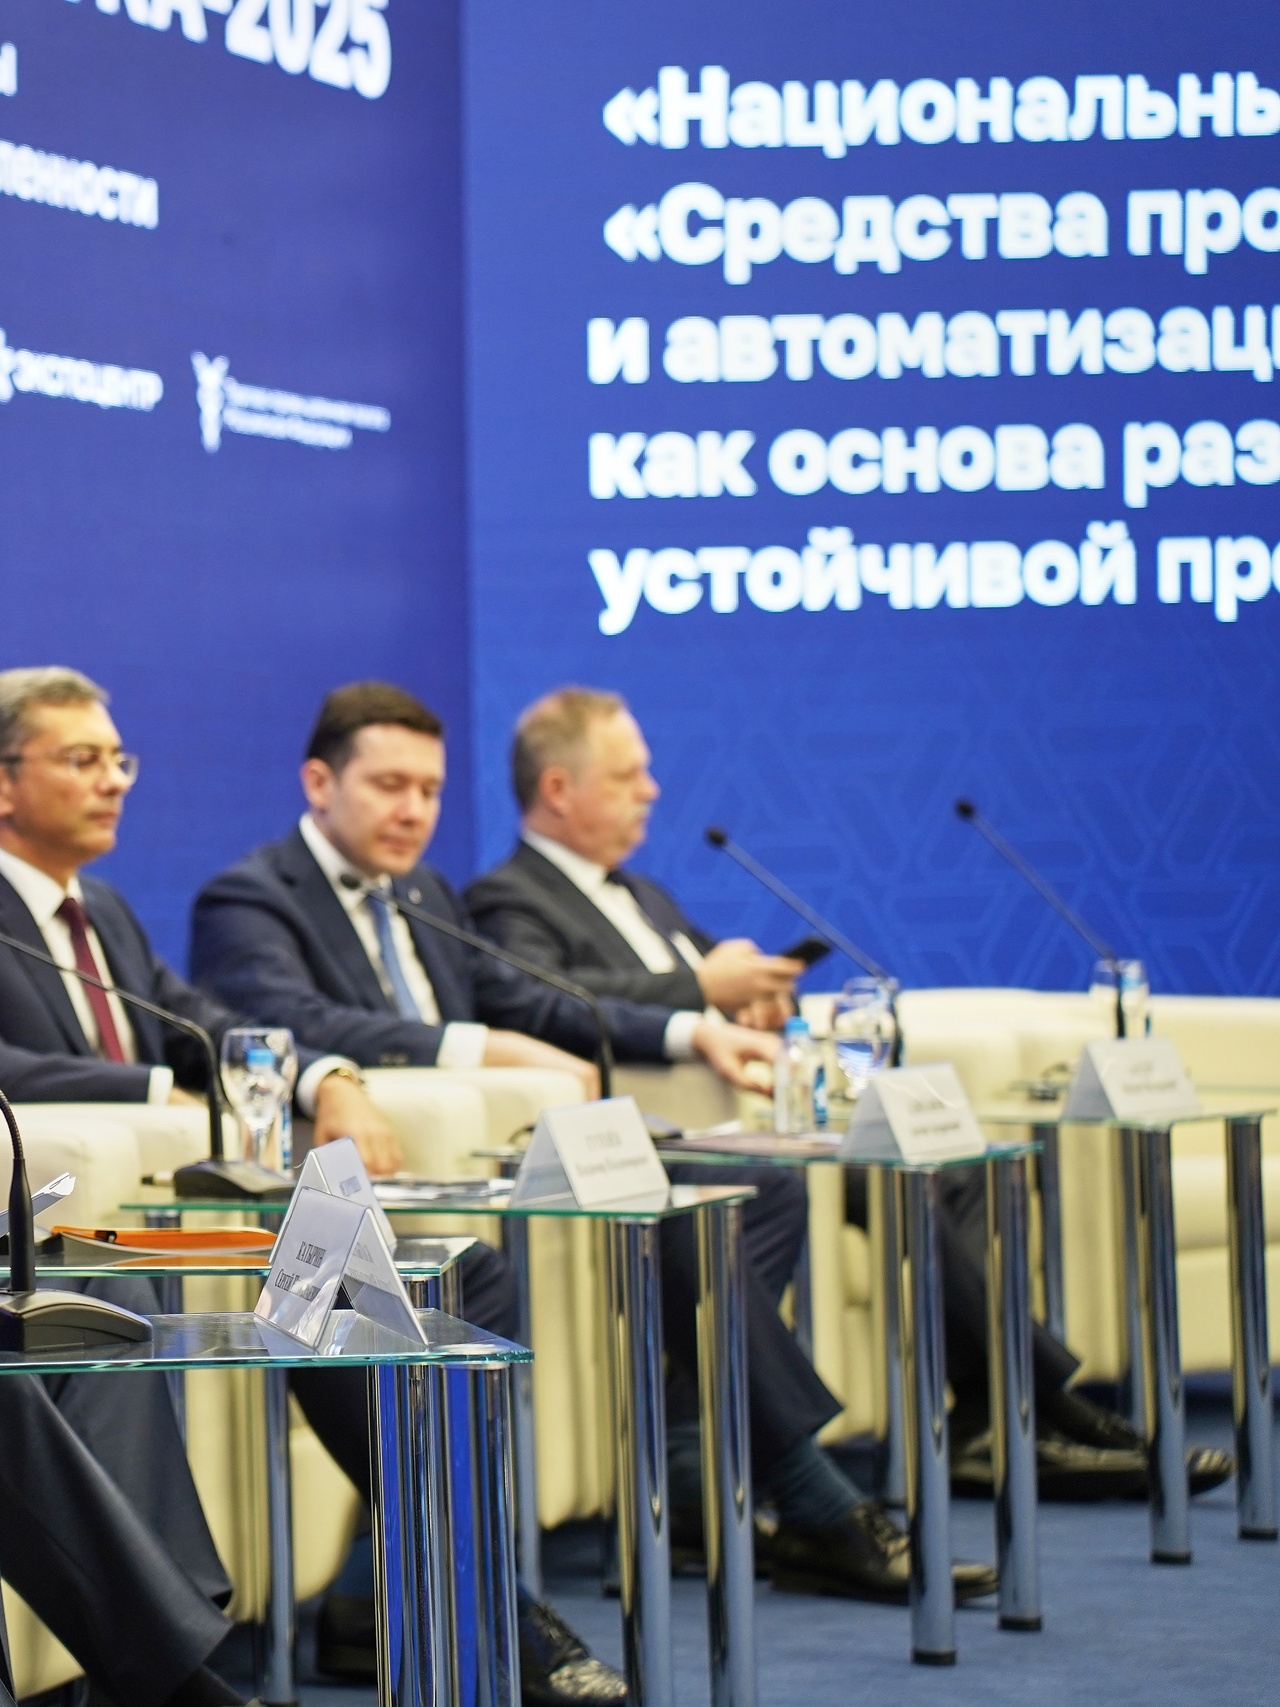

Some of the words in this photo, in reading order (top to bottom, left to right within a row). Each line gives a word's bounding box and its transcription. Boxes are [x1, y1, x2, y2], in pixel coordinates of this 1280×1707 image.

[604, 182, 1107, 284] «Средства
[1129, 188, 1280, 274] про
[588, 317, 649, 384] и
[663, 306, 1280, 382] автоматизац
[590, 430, 756, 499] как
[769, 424, 1104, 495] основа
[1124, 419, 1280, 508] раз
[588, 522, 1136, 635] устойчивой
[1158, 537, 1280, 622] пр
